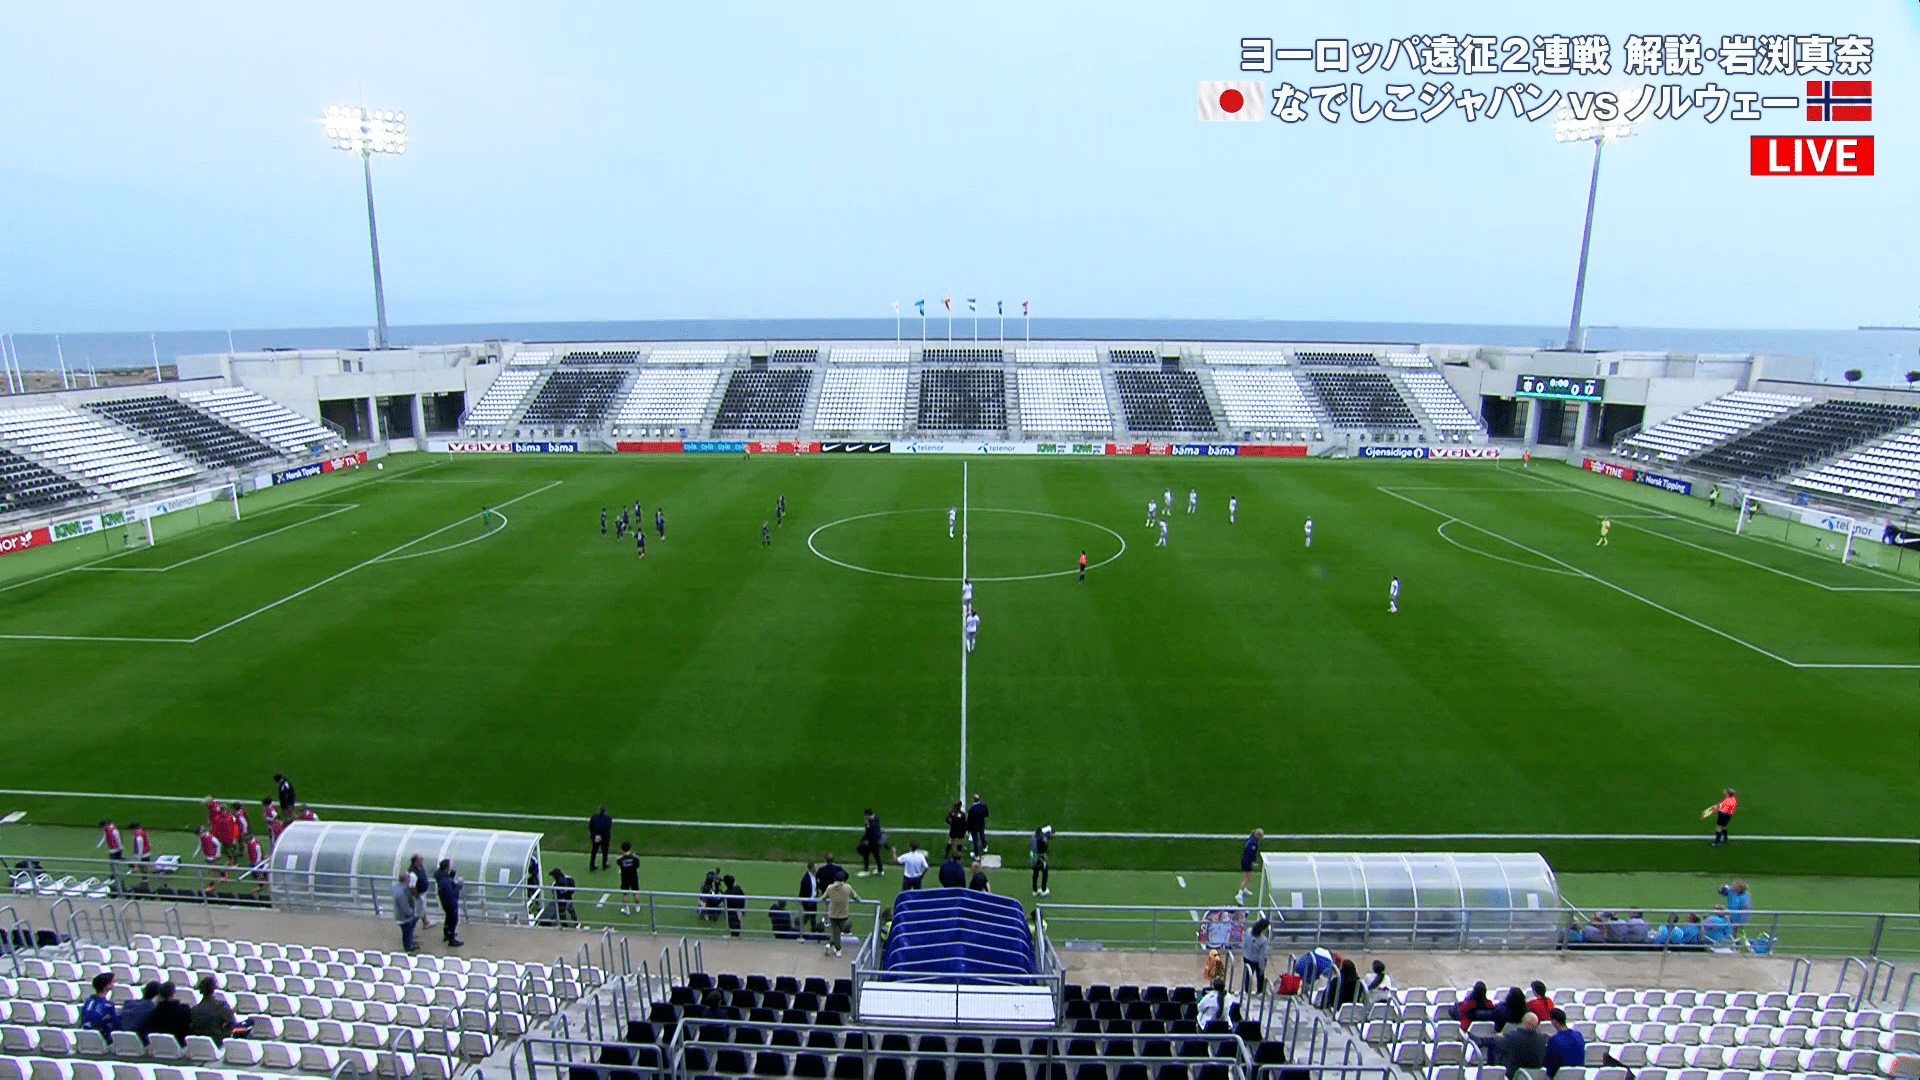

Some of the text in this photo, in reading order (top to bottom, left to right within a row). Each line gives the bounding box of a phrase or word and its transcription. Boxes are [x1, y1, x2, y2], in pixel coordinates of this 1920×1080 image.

[515, 443, 574, 452] bama bama
[989, 444, 1016, 452] telenor
[1172, 445, 1200, 455] bama
[1207, 445, 1236, 455] bama
[1365, 447, 1412, 458] Gjensidige
[1605, 465, 1624, 479] TINE
[1645, 475, 1685, 494] Norsk Tipping
